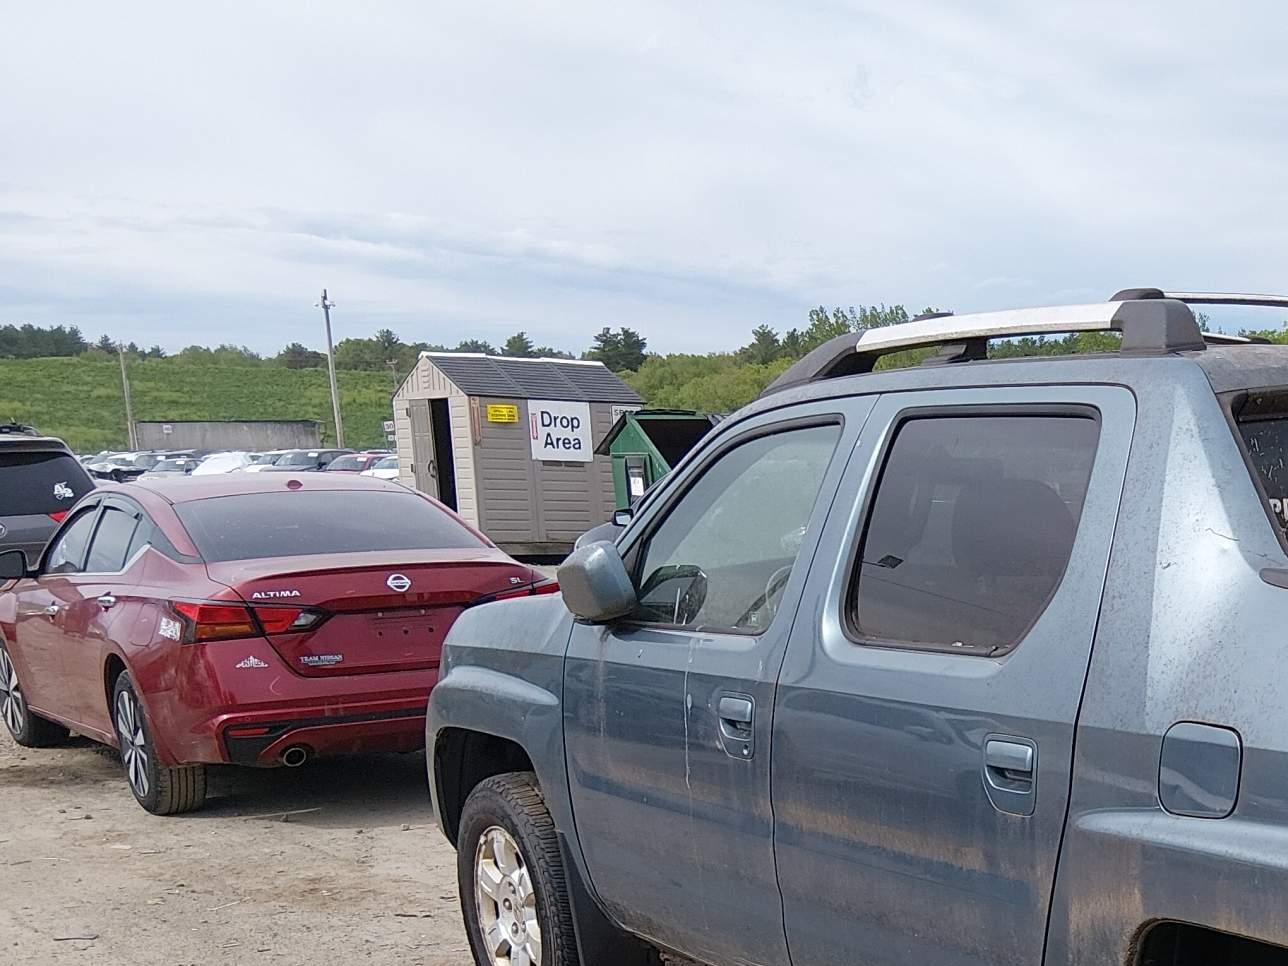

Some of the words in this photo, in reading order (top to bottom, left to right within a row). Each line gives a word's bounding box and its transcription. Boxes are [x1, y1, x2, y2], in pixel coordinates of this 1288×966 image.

[541, 411, 580, 432] Drop
[544, 433, 582, 450] Area
[252, 590, 301, 599] ALTIMA
